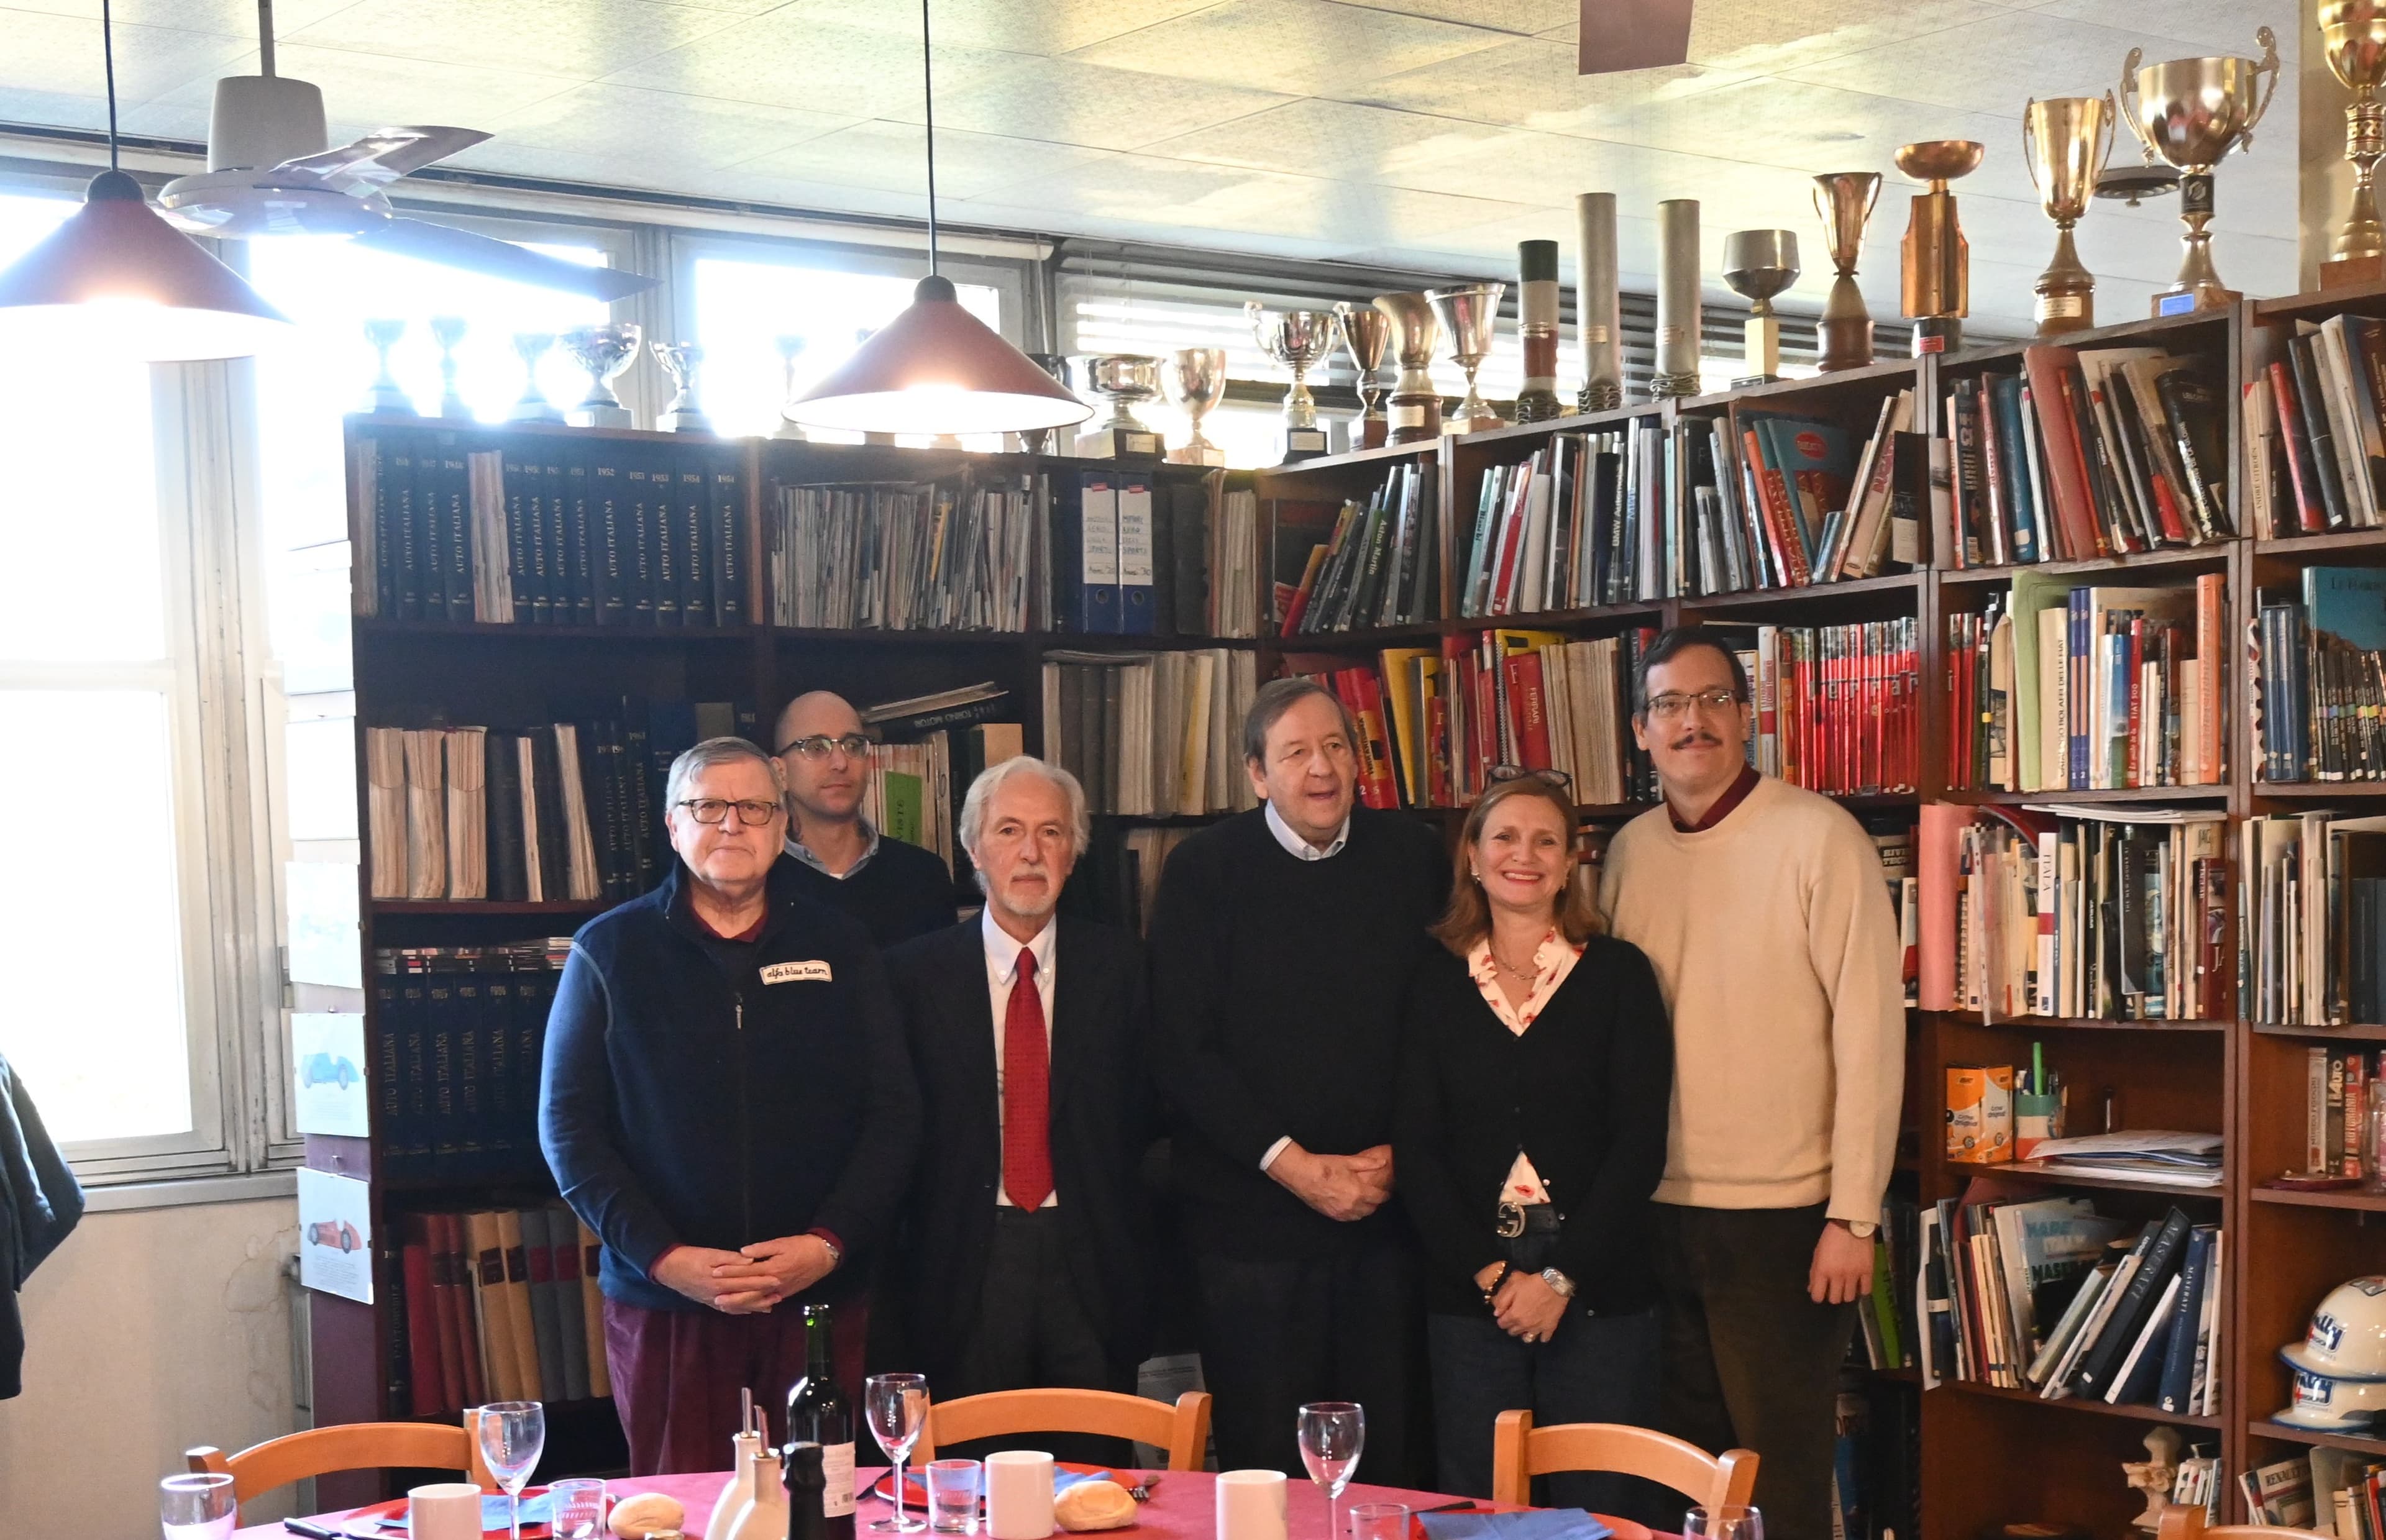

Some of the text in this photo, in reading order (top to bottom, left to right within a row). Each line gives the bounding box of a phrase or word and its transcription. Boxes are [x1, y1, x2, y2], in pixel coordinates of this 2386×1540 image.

[531, 496, 545, 577] AUTO ITALIANA
[552, 498, 563, 547] ITALIANA
[604, 499, 619, 578] AUTO ITALIANA
[635, 501, 647, 580] AUTO ITALIANA
[659, 504, 672, 582] AUTO ITALIANA
[688, 504, 702, 581] AUTO ITALIANA
[723, 504, 735, 581] AUTO ITALIANA
[1369, 519, 1387, 576] Aston Martin
[1529, 686, 1539, 724] FERRARI
[2042, 854, 2052, 892] ITALA
[766, 967, 828, 979] alfa blue team
[2344, 1092, 2357, 1144] AUTOMANIA
[2179, 1265, 2195, 1313] MASERATI
